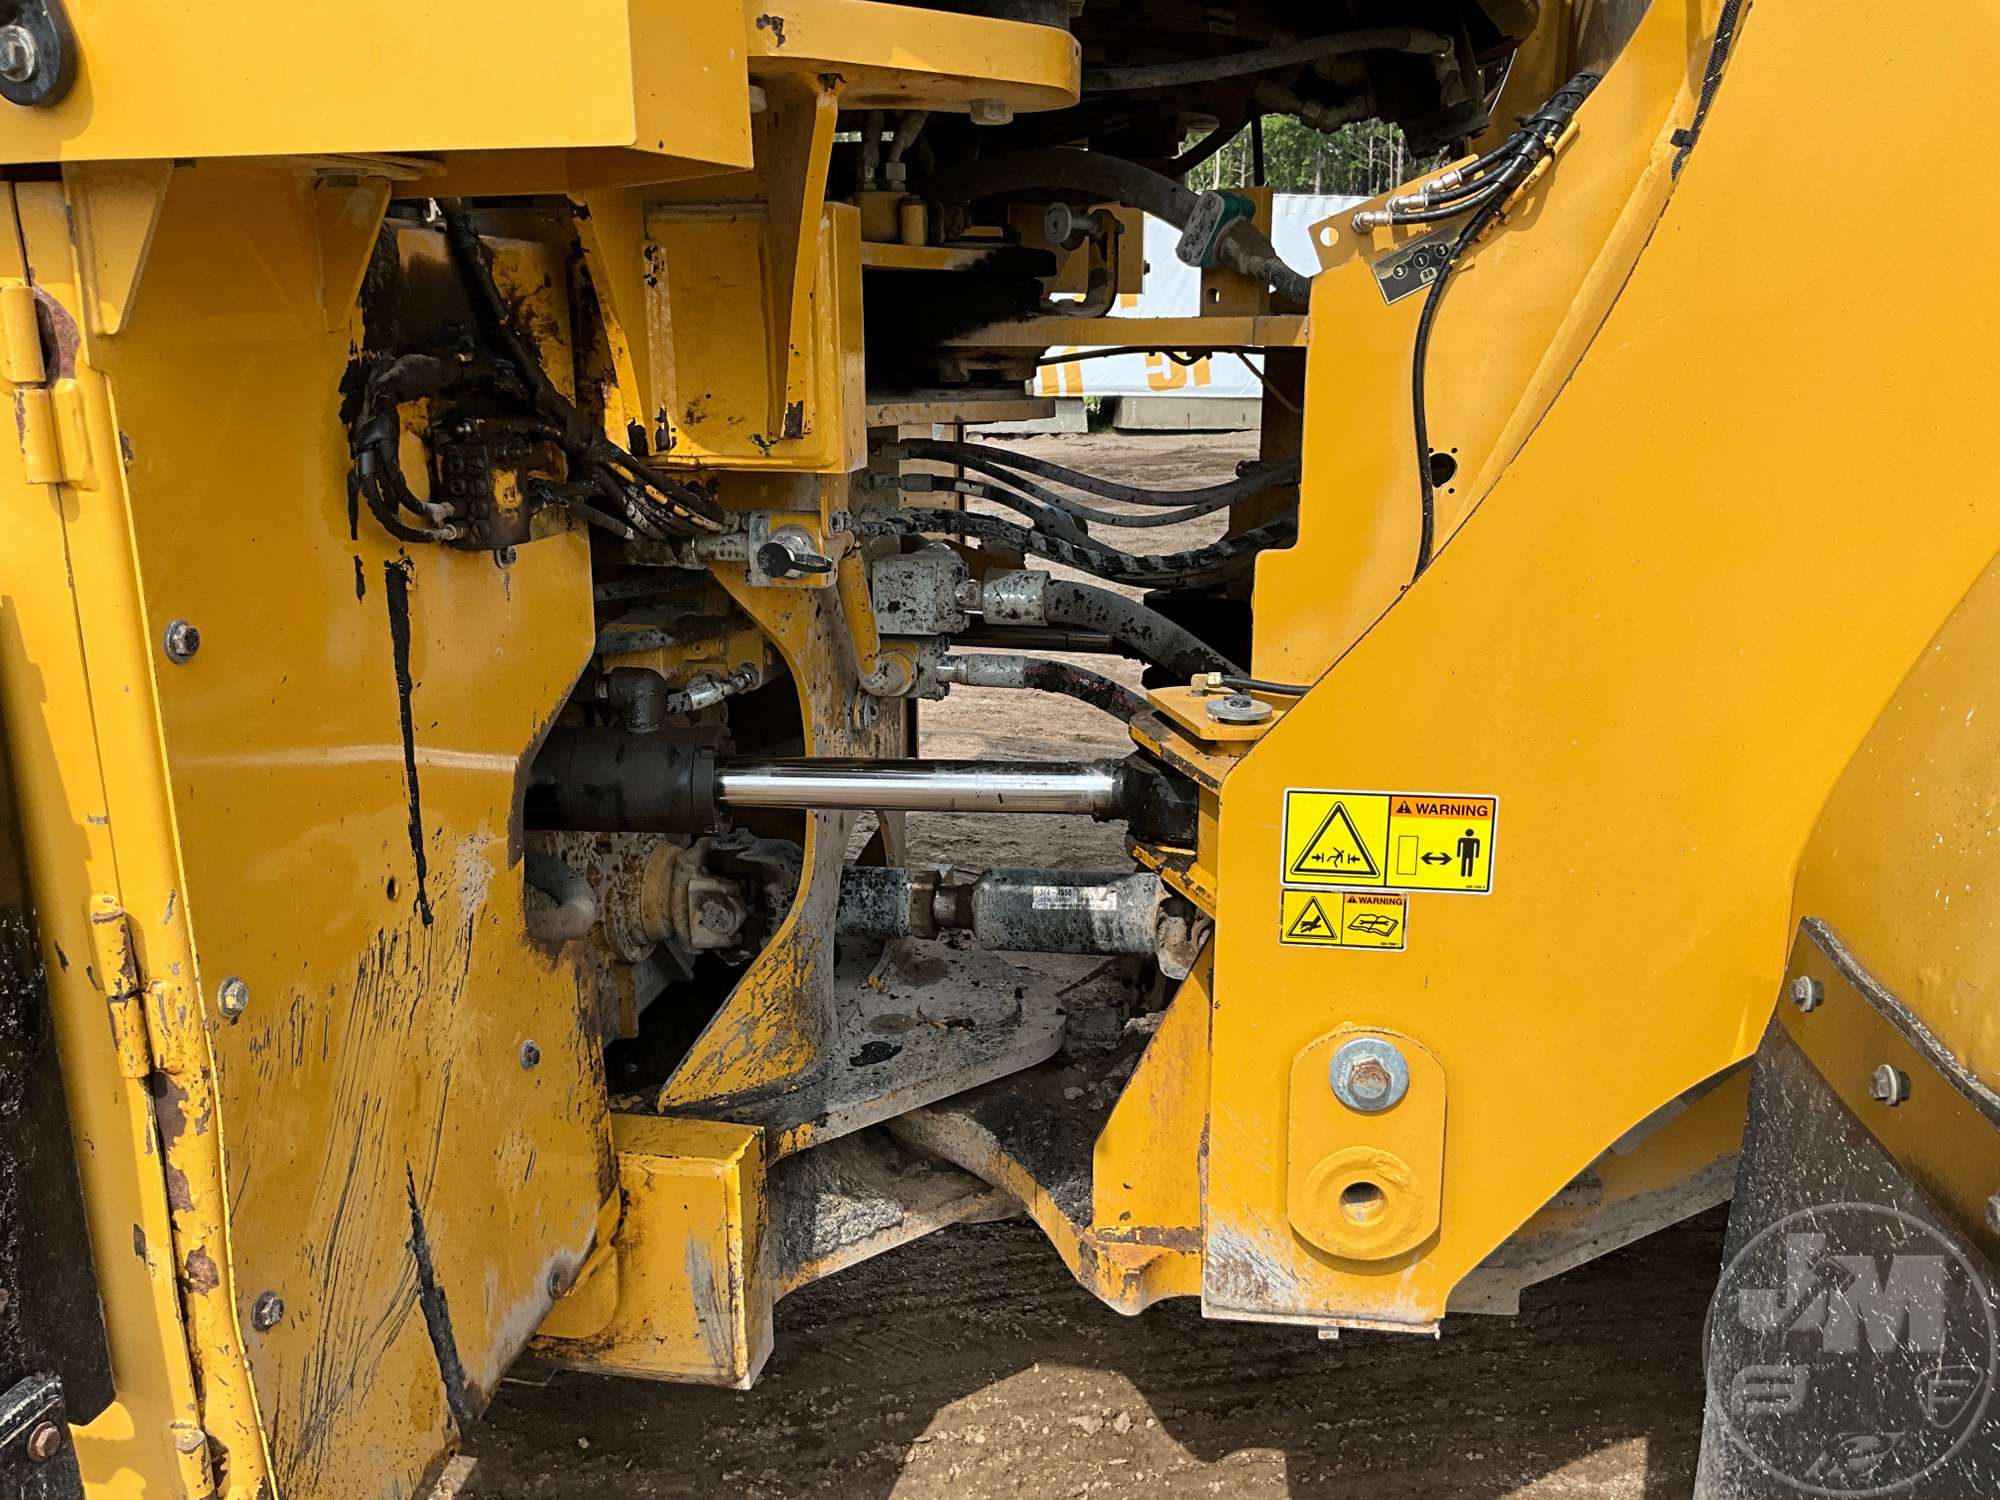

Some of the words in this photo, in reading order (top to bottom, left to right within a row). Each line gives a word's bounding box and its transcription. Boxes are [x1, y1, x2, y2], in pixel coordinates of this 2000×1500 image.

[1440, 246, 1446, 254] 3
[1396, 267, 1403, 276] 3
[1415, 802, 1488, 817] WARNING
[1358, 896, 1403, 906] WARNING
